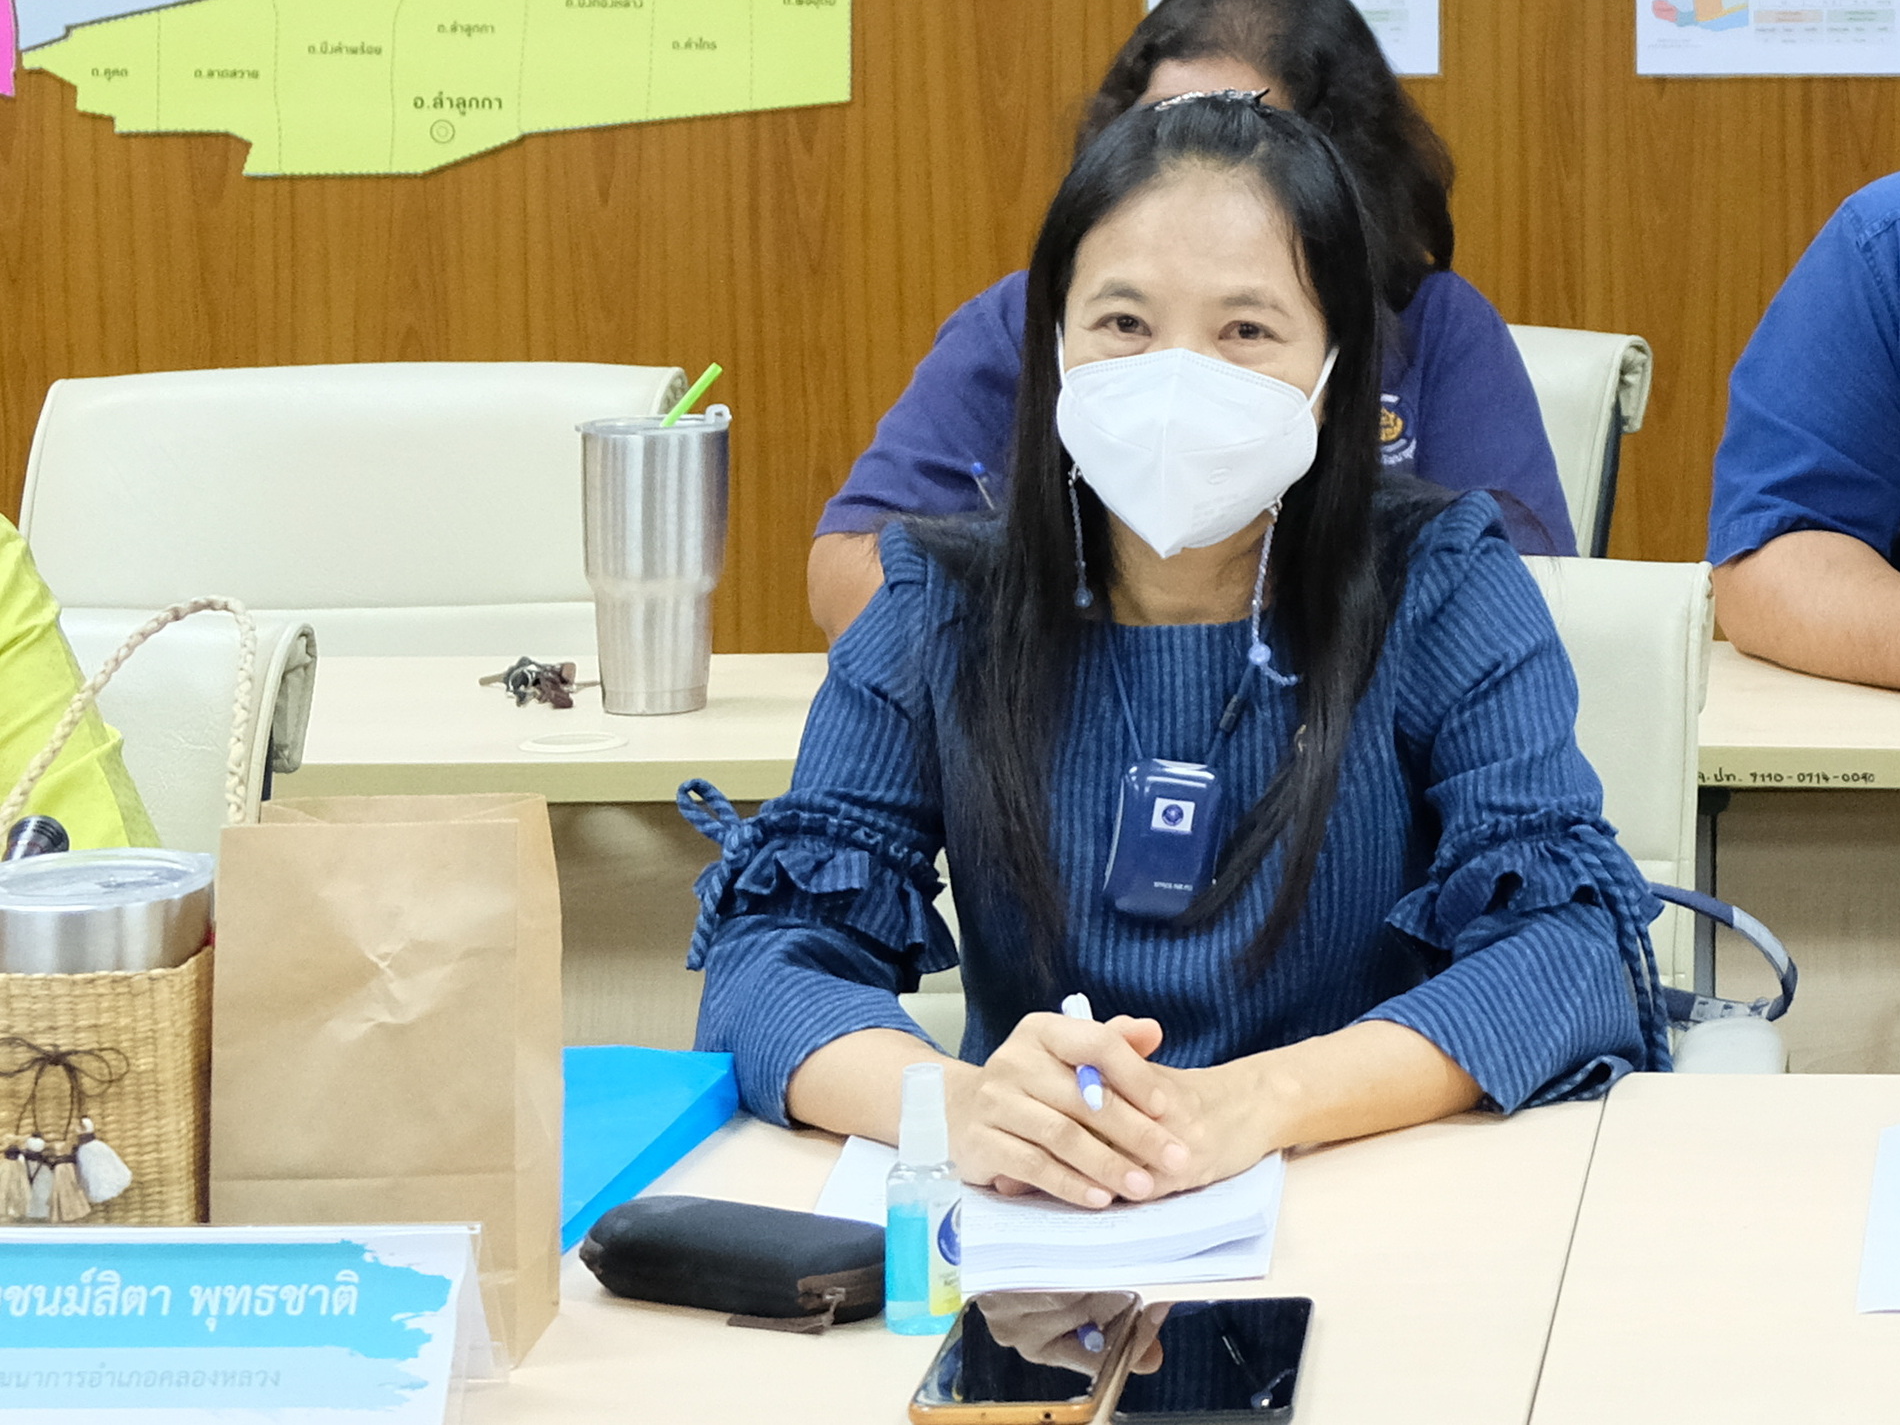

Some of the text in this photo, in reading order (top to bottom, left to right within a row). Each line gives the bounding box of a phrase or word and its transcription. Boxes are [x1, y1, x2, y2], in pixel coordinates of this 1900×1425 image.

[413, 91, 502, 116] อ.ลำลูกกา
[0, 1267, 361, 1333] ชนม์สิตา พุทธชาติ
